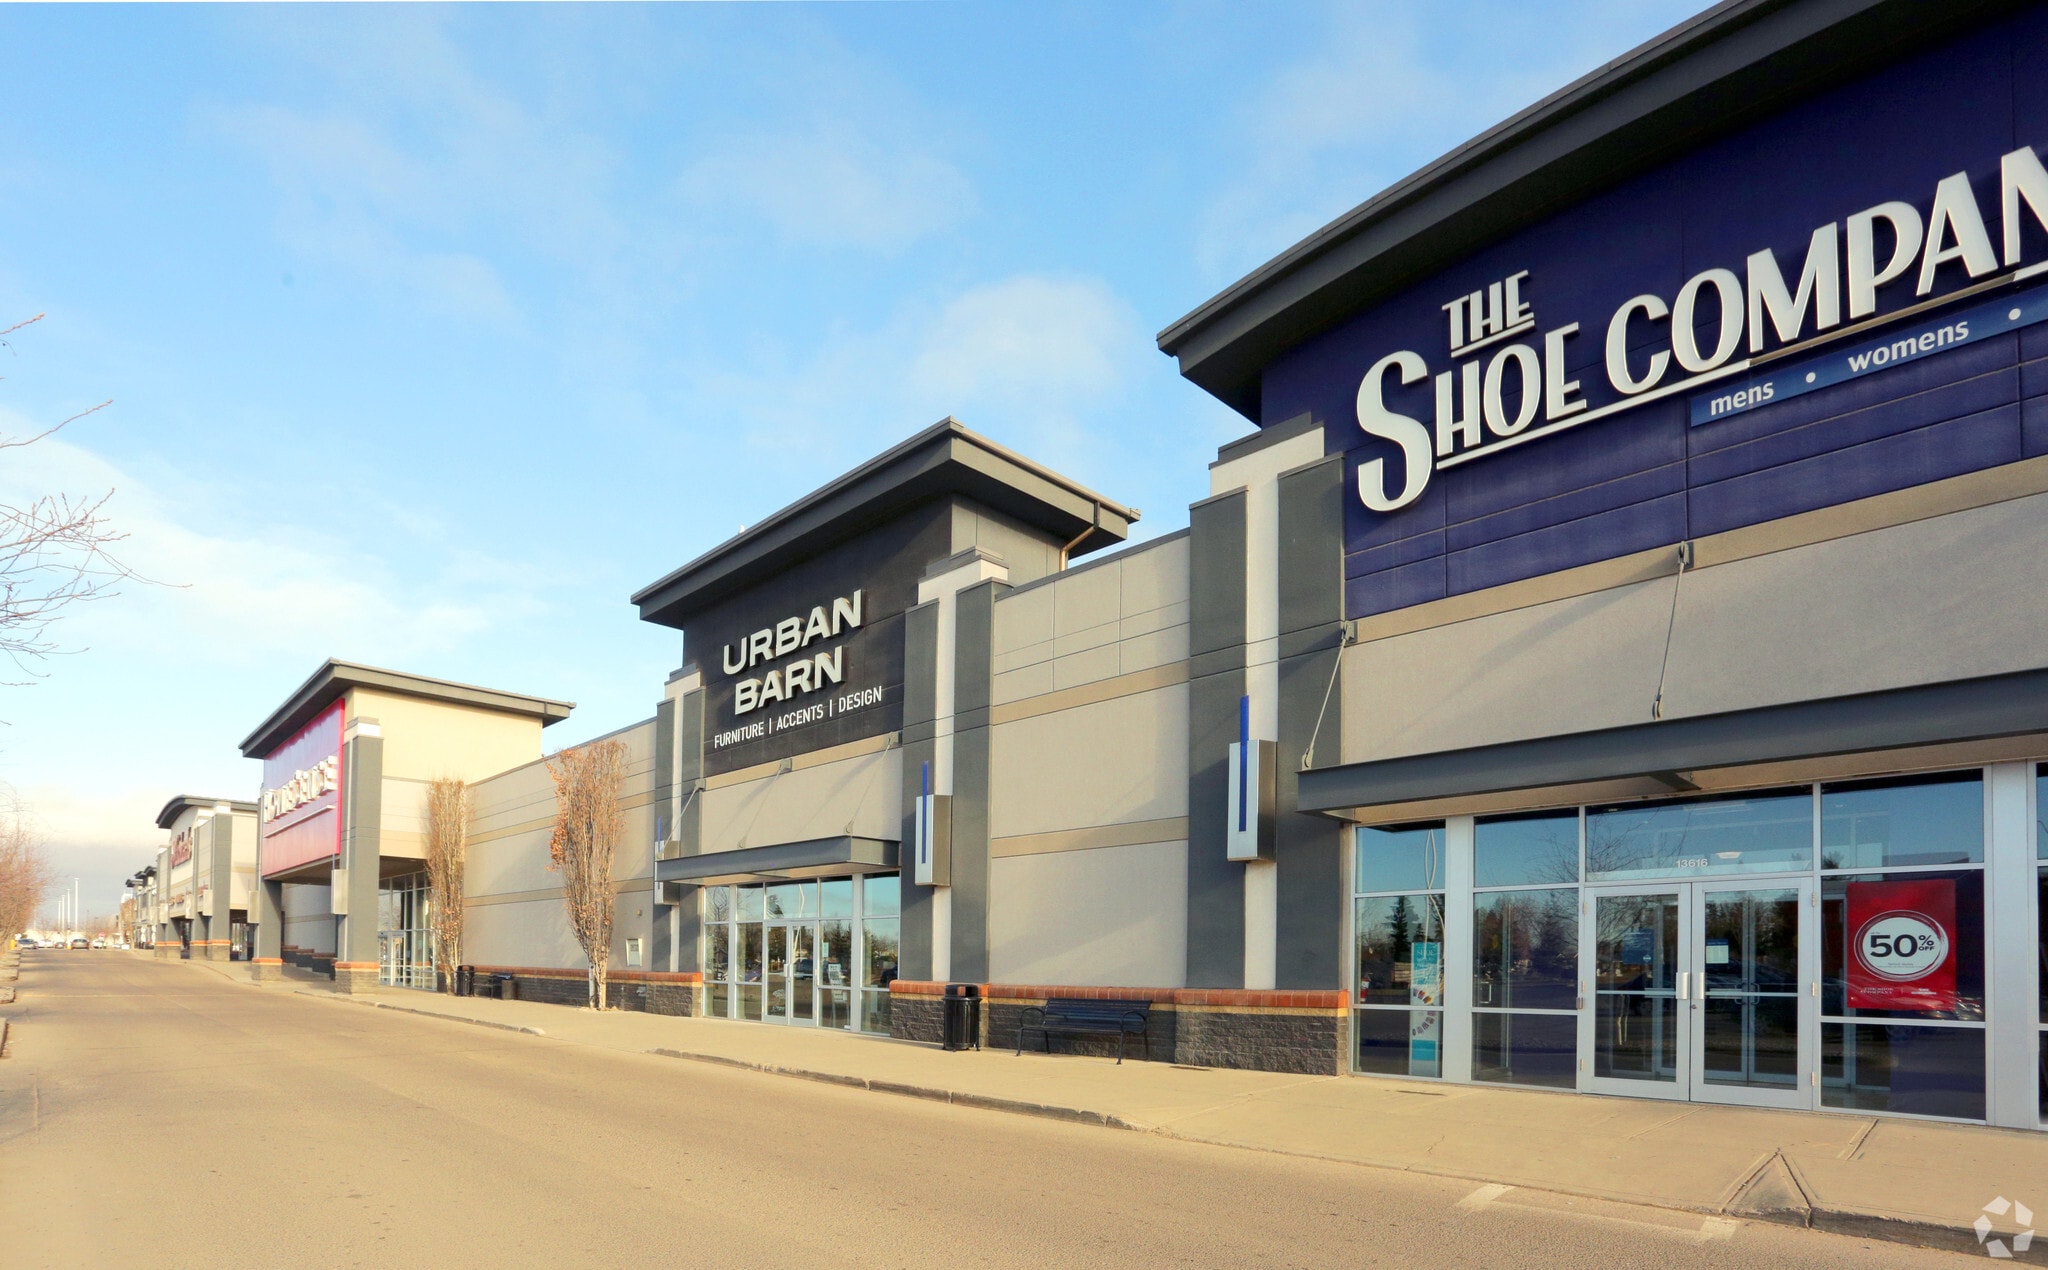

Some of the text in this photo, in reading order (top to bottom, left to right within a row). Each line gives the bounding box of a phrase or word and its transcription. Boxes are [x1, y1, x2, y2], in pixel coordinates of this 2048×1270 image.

[1441, 269, 1535, 350] THE
[1710, 317, 1970, 416] mens womens
[1356, 321, 1587, 512] SHOE
[722, 588, 863, 676] URBAN
[714, 685, 883, 749] FURNITURE ACCENTS DESIGN
[734, 644, 845, 716] BARN
[1675, 858, 1708, 869] 13616
